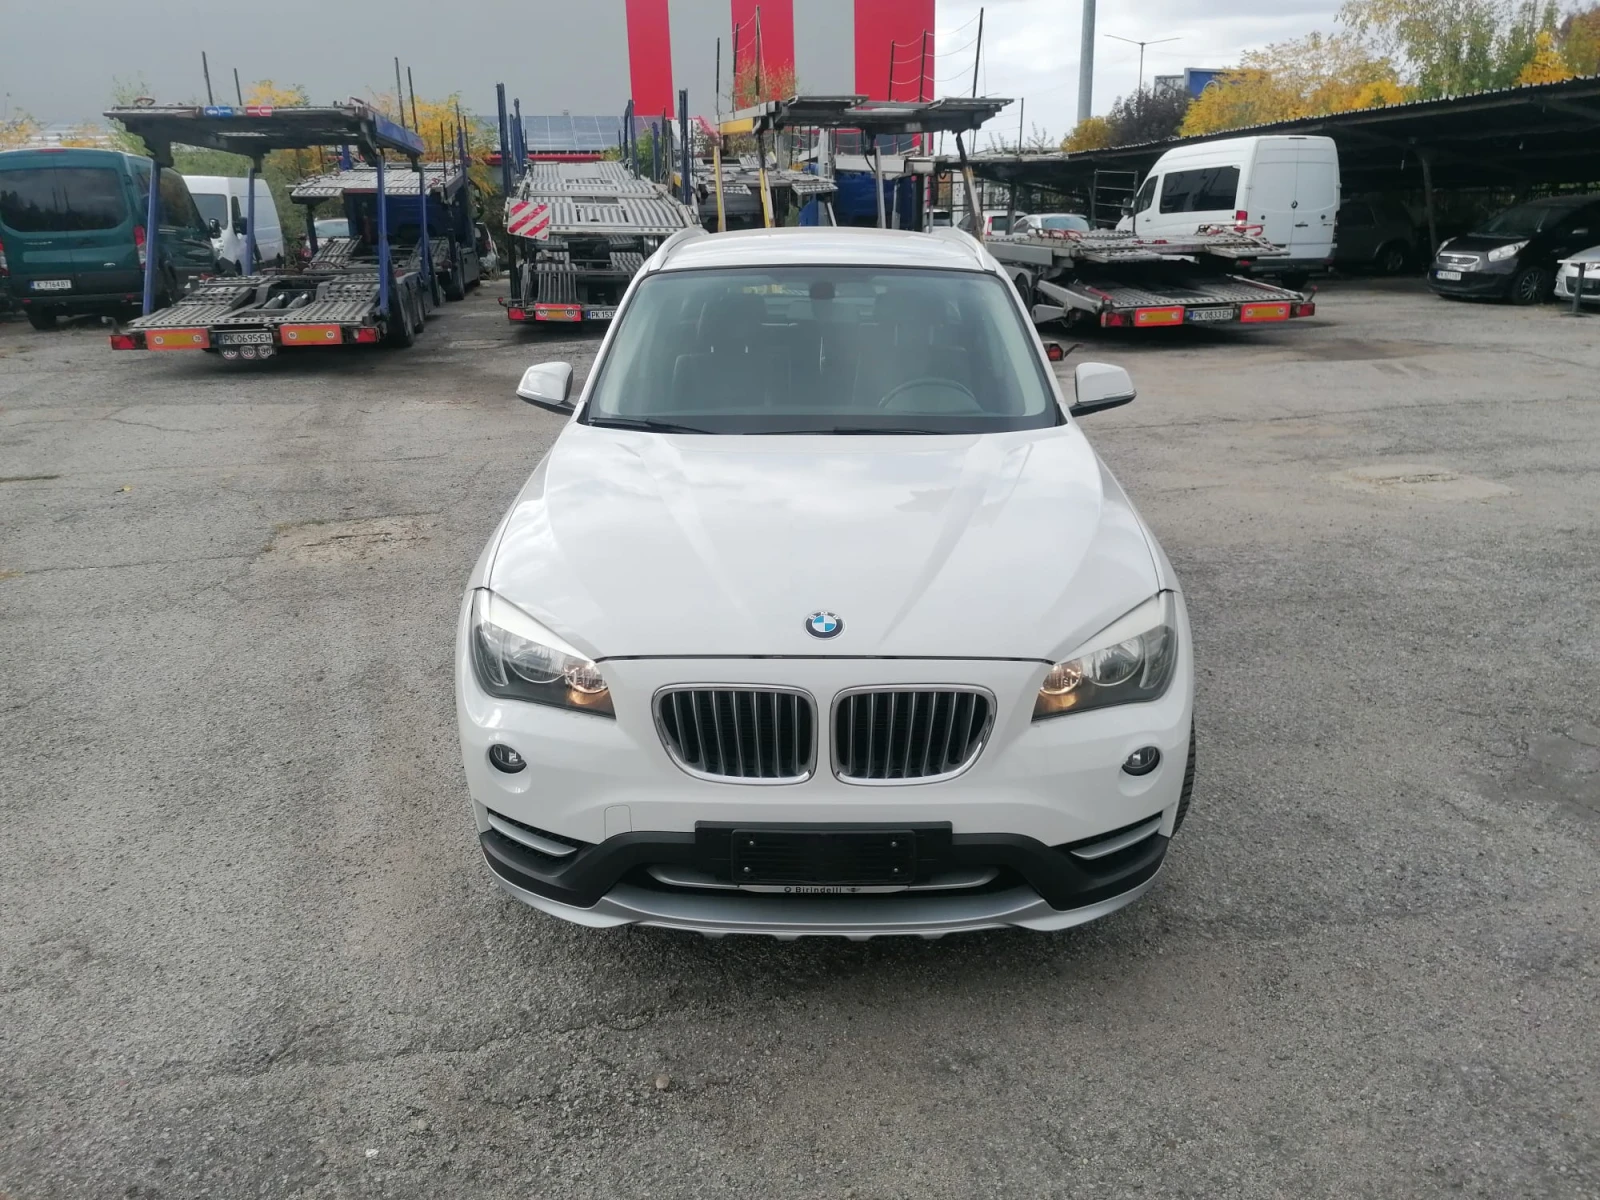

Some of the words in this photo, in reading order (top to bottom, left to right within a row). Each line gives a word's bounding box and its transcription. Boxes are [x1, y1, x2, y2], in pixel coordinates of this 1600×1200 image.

[592, 311, 601, 319] PK
[1194, 311, 1204, 320] PK
[1222, 310, 1233, 319] EH
[223, 334, 236, 343] PK
[237, 334, 258, 343] 0695
[259, 333, 272, 343] EH
[795, 886, 842, 894] Birindelli
